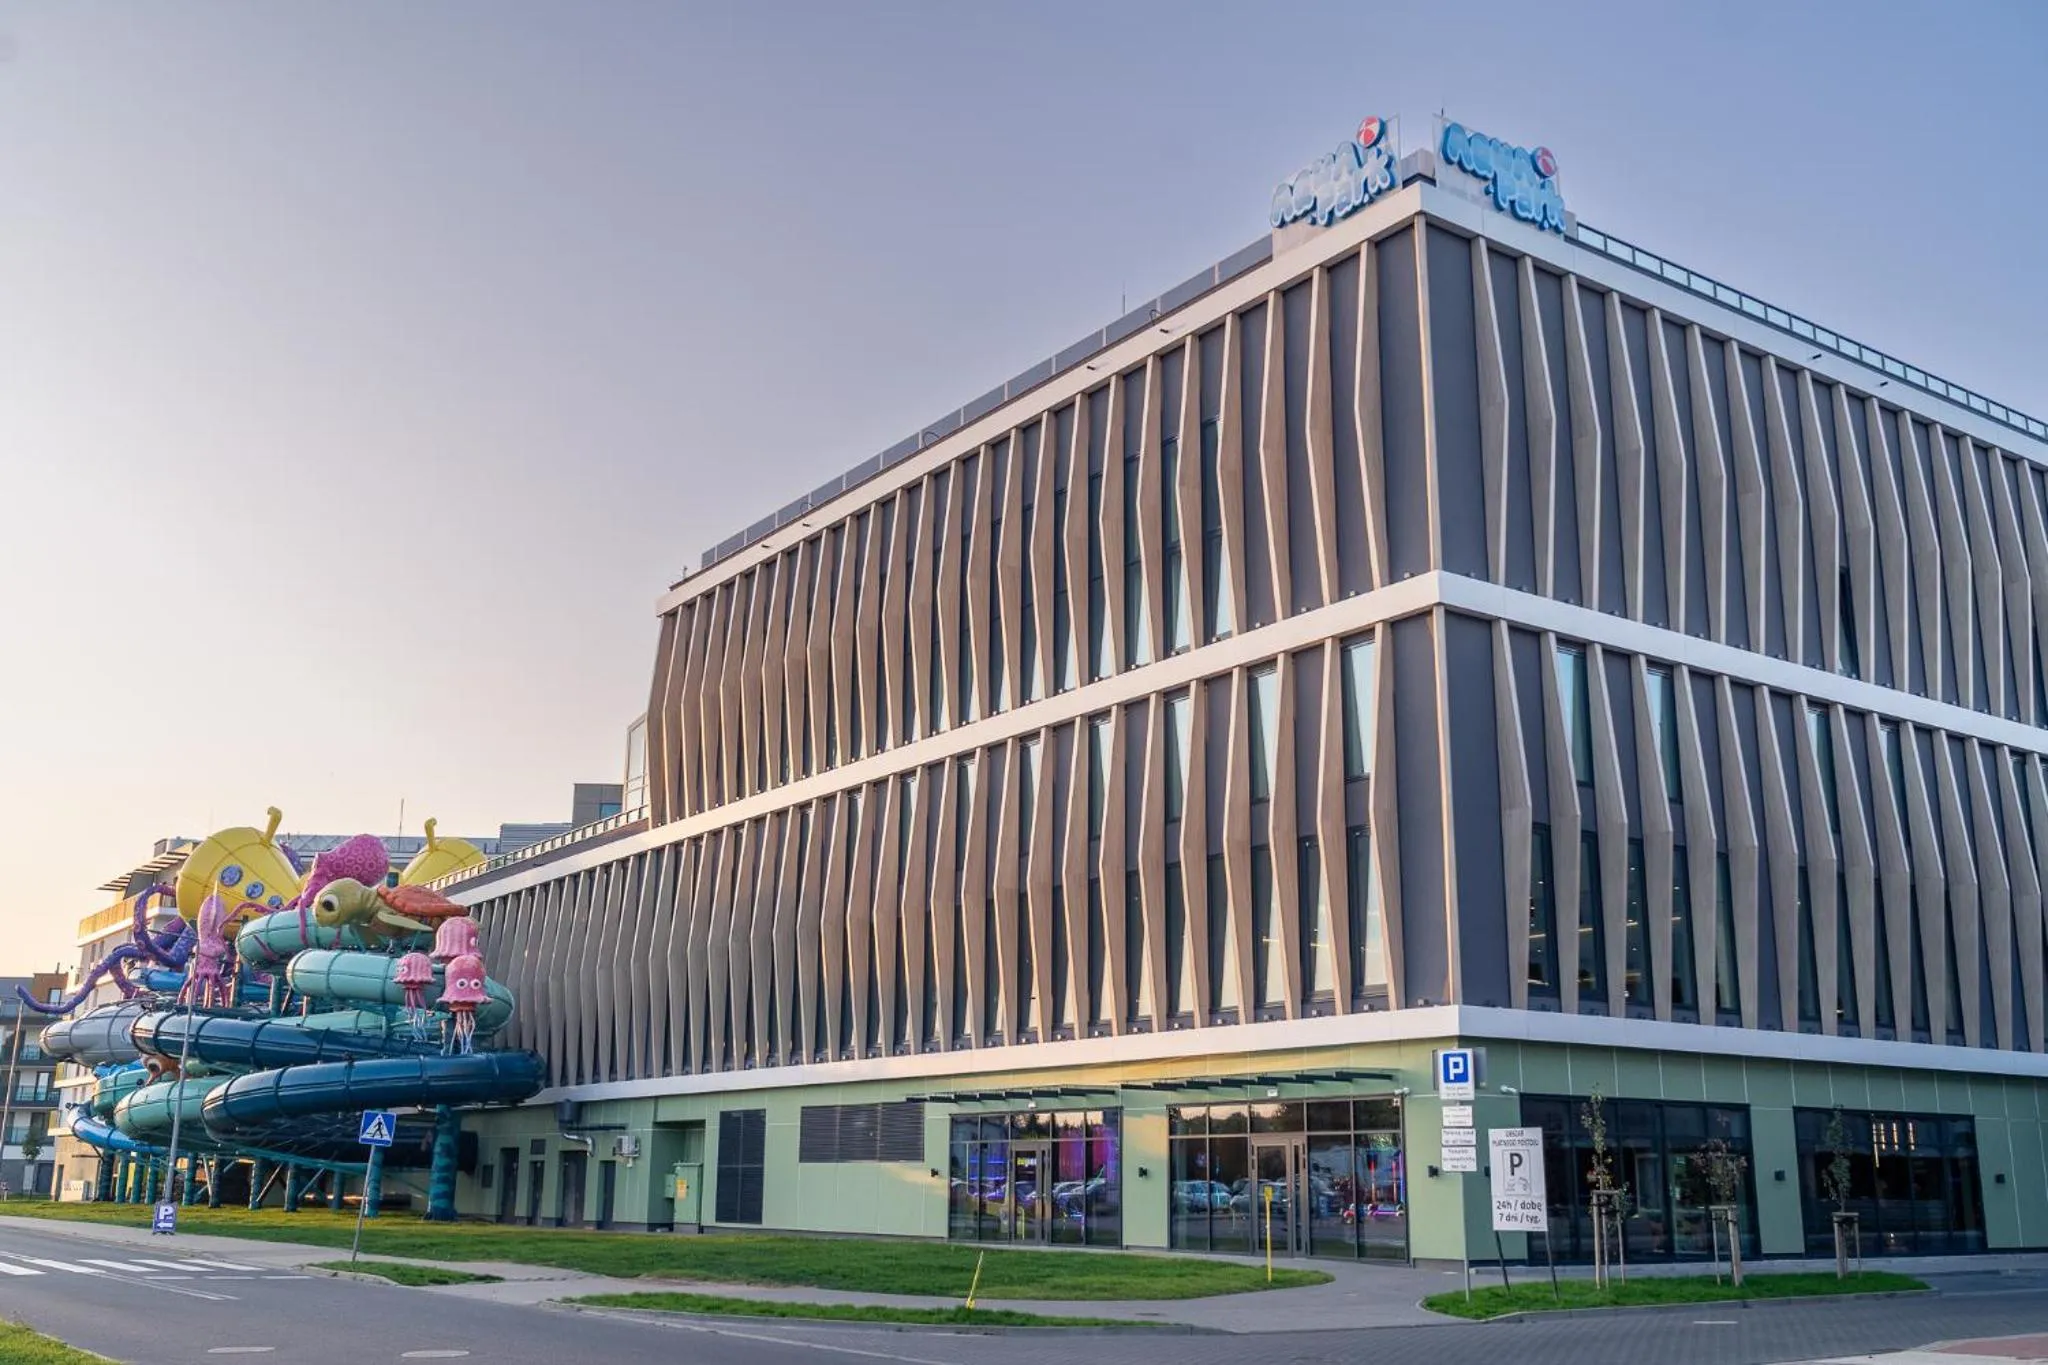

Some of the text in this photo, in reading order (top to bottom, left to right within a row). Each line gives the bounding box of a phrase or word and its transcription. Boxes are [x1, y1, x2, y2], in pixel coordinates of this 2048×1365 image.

[1448, 1056, 1464, 1080] P
[1509, 1152, 1523, 1176] P
[159, 1205, 174, 1219] P
[1496, 1200, 1512, 1210] 24h
[1520, 1200, 1542, 1212] dobę
[1499, 1213, 1504, 1222] 7
[1505, 1212, 1518, 1222] dni
[1525, 1213, 1541, 1224] tyg.
